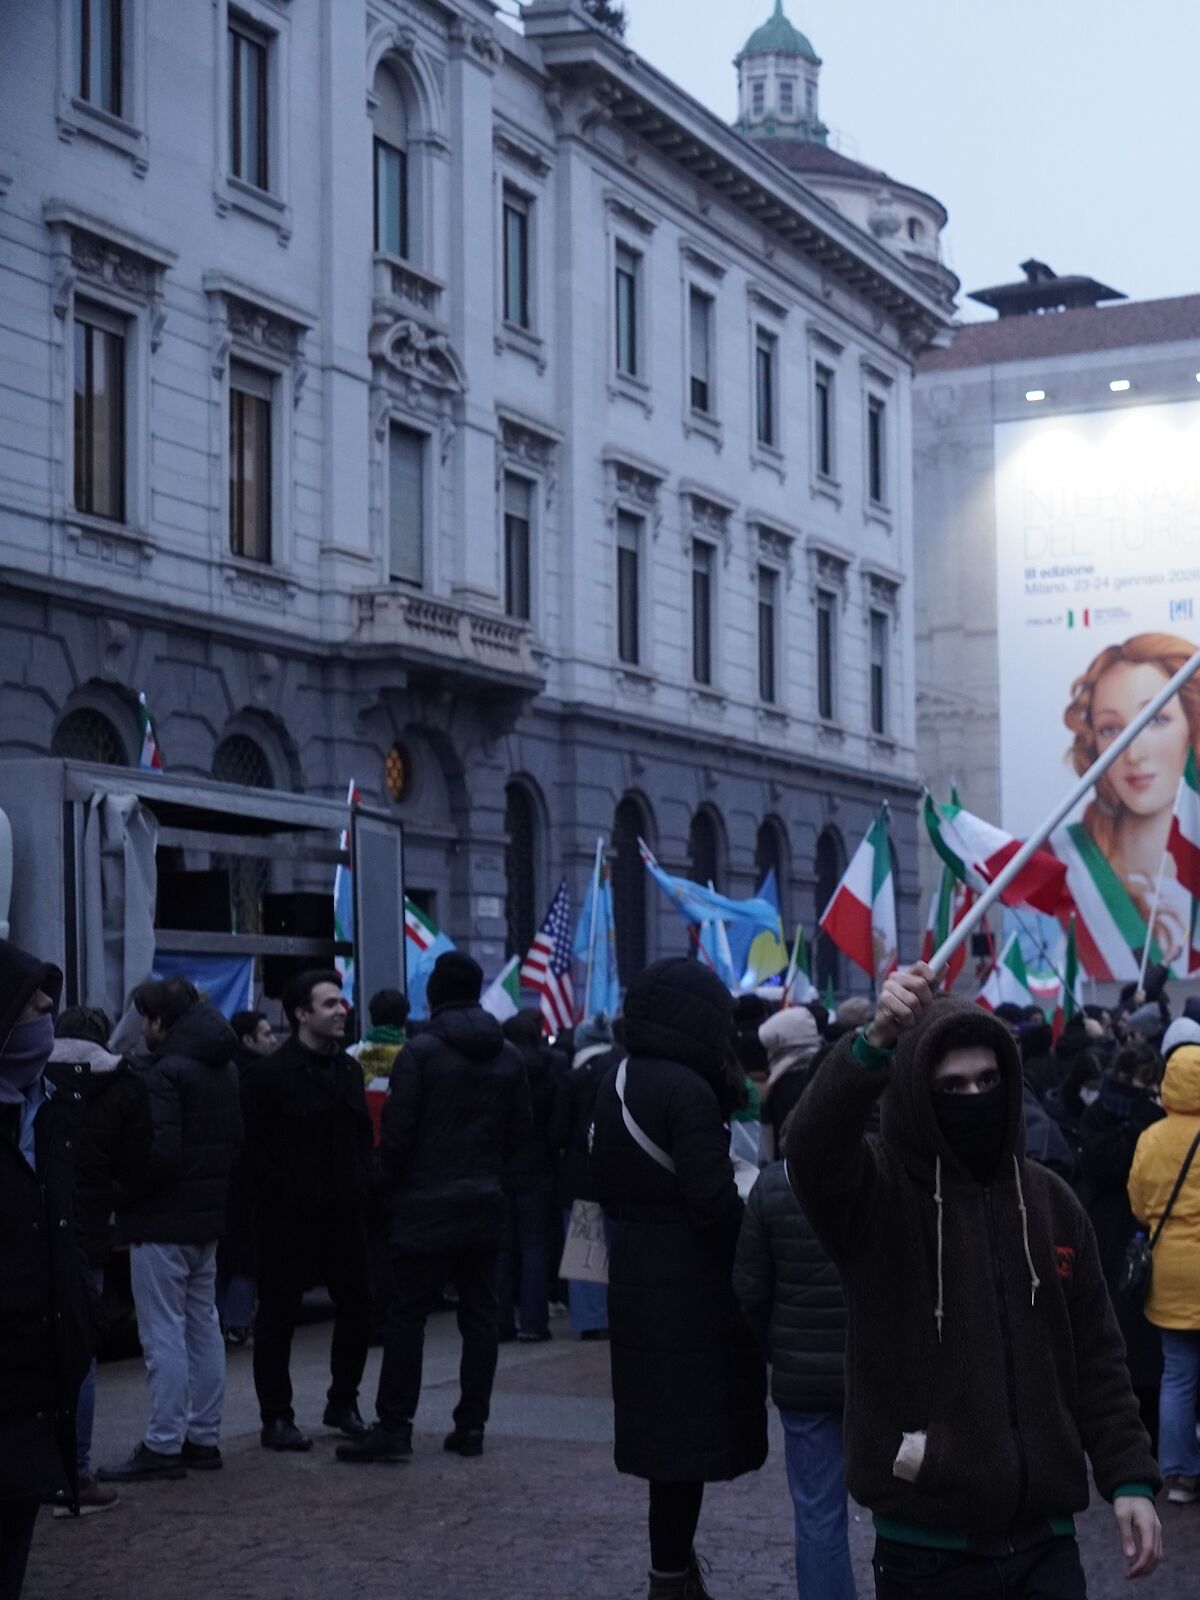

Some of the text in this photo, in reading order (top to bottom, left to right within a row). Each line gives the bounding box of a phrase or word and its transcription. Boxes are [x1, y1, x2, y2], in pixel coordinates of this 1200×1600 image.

[1024, 522, 1090, 561] DEL
[1040, 564, 1094, 579] edizione
[1073, 577, 1109, 591] 23-24
[1113, 574, 1164, 591] gennaio
